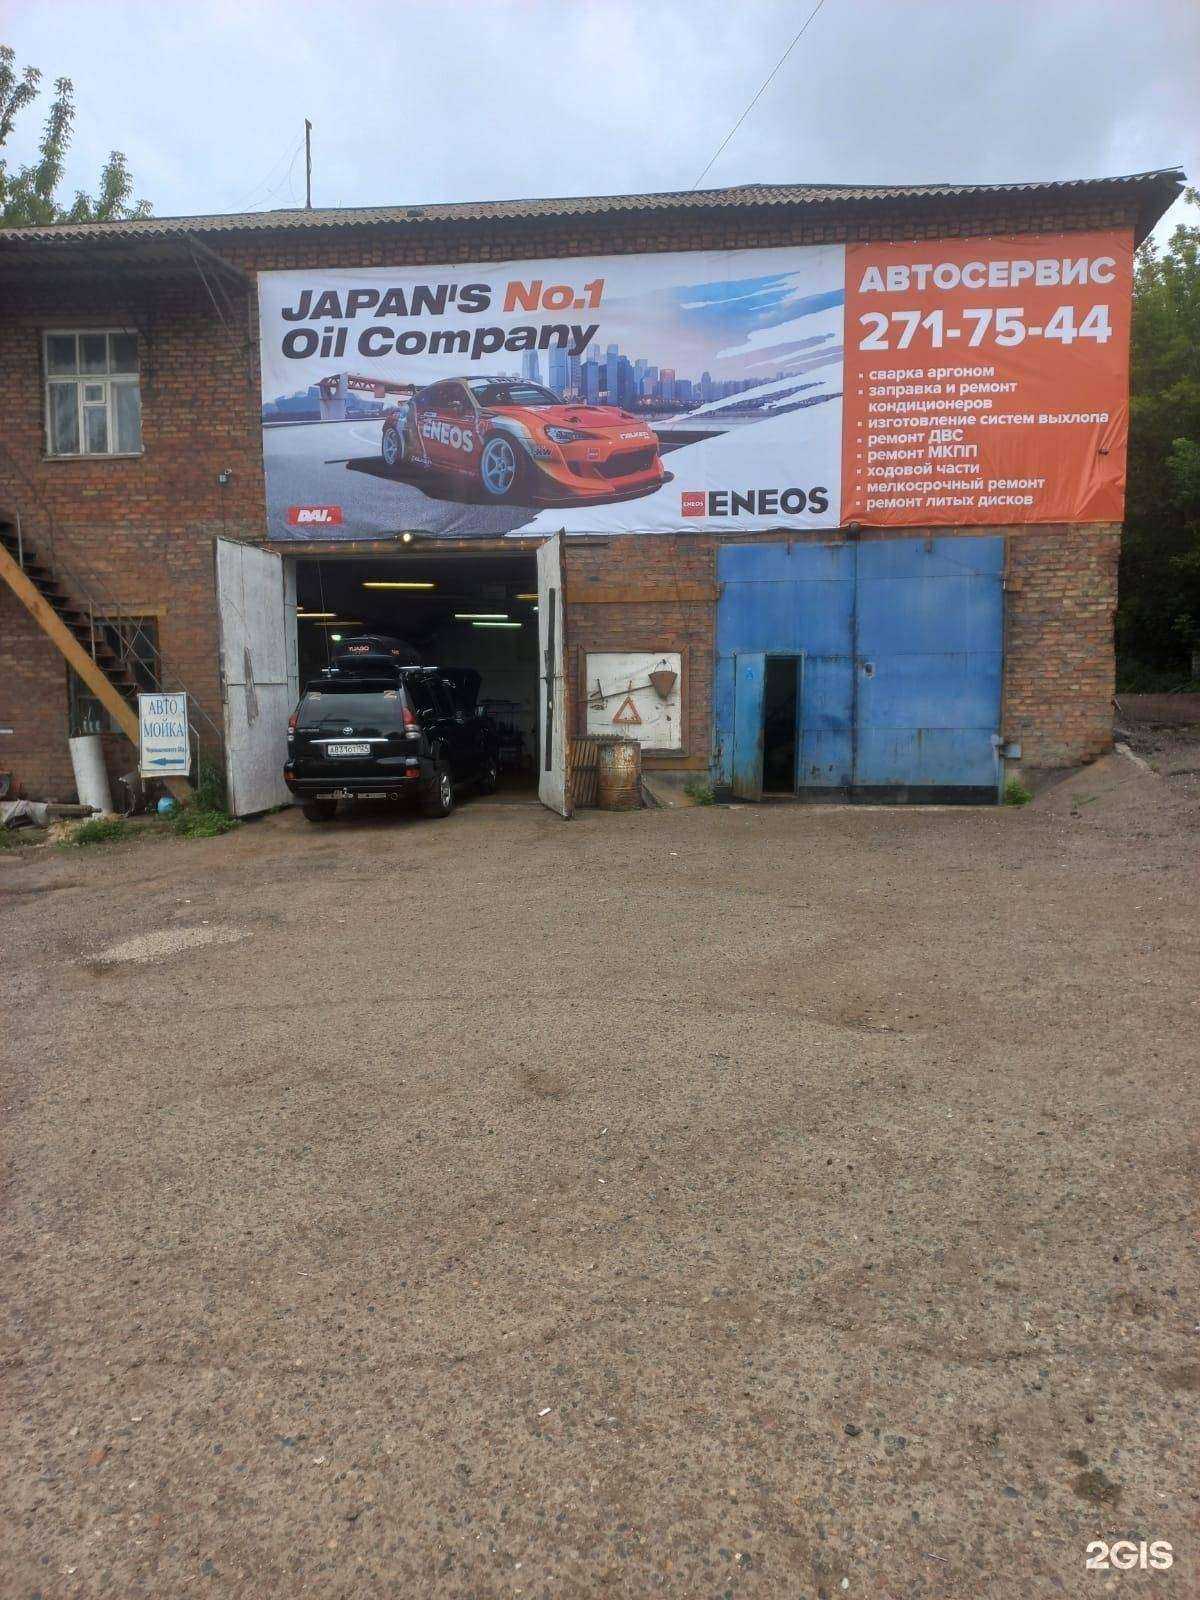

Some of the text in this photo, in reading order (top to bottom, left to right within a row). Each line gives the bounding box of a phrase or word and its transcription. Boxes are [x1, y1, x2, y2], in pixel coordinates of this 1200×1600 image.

[859, 257, 1116, 293] АВТОСЕРВИС
[281, 279, 605, 321] JAPAN'S No.1
[859, 304, 1112, 351] 271-75-44
[282, 324, 600, 360] Oil Company
[869, 367, 994, 382] сварка аргоном
[868, 382, 1018, 398] заправка и ремонт
[869, 399, 993, 413] кондиционеров
[868, 413, 1109, 429] изготовление систем выхлопа
[422, 420, 474, 453] ENEOS
[868, 429, 964, 447] ремонт ДВС
[867, 444, 978, 463] ремонт МКПП
[867, 463, 980, 479] ходовой части
[867, 477, 1046, 494] мелкосрочный ремонт
[709, 486, 829, 517] ENEOS
[867, 495, 1033, 511] ремонт литых дисков
[149, 699, 178, 715] АВТО
[143, 718, 184, 737] МОЙКА
